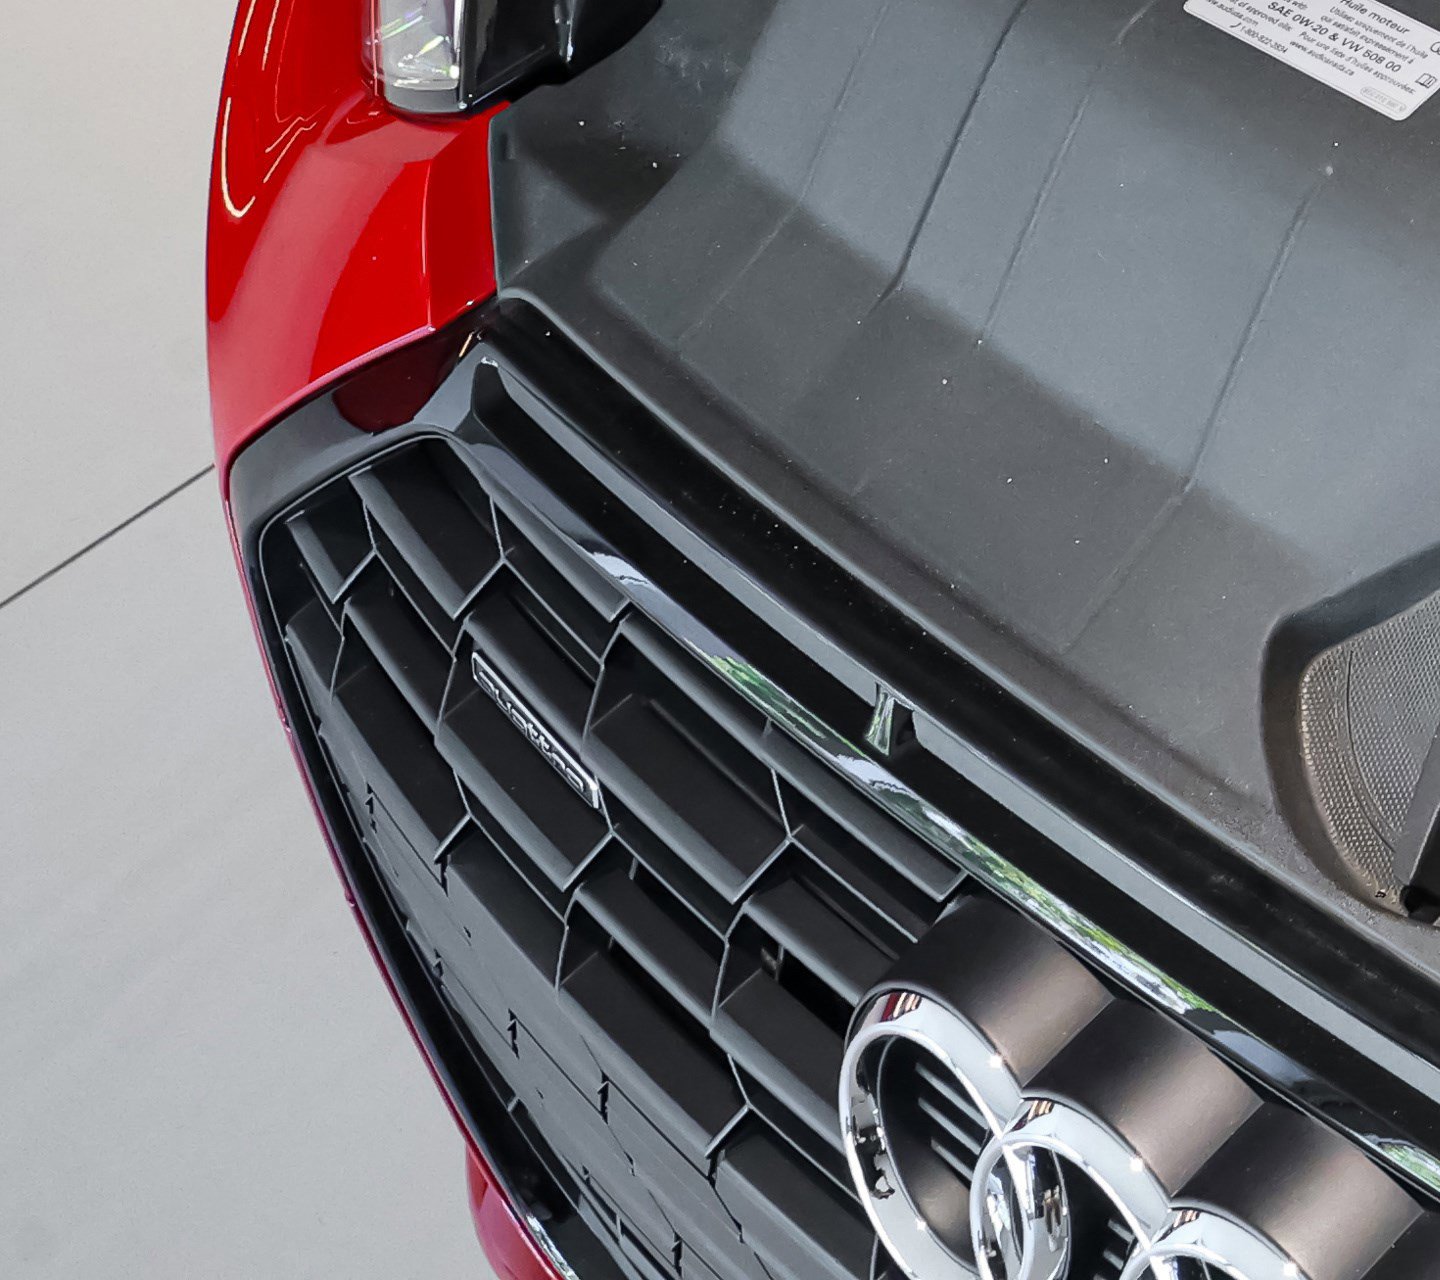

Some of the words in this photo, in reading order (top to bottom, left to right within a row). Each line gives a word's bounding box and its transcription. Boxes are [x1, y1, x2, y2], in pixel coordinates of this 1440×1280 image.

[1245, 5, 1280, 25] approved
[1368, 12, 1410, 34] moteur
[1267, 1, 1294, 18] SAE
[1292, 14, 1329, 35] 0W-20
[1328, 32, 1339, 42] &
[1341, 37, 1364, 53] VW
[1362, 49, 1386, 65] 508
[1384, 60, 1402, 73] 00
[1298, 31, 1317, 43] Pour
[1315, 41, 1331, 51] une
[1395, 40, 1407, 48] de
[477, 671, 586, 793] quattro
